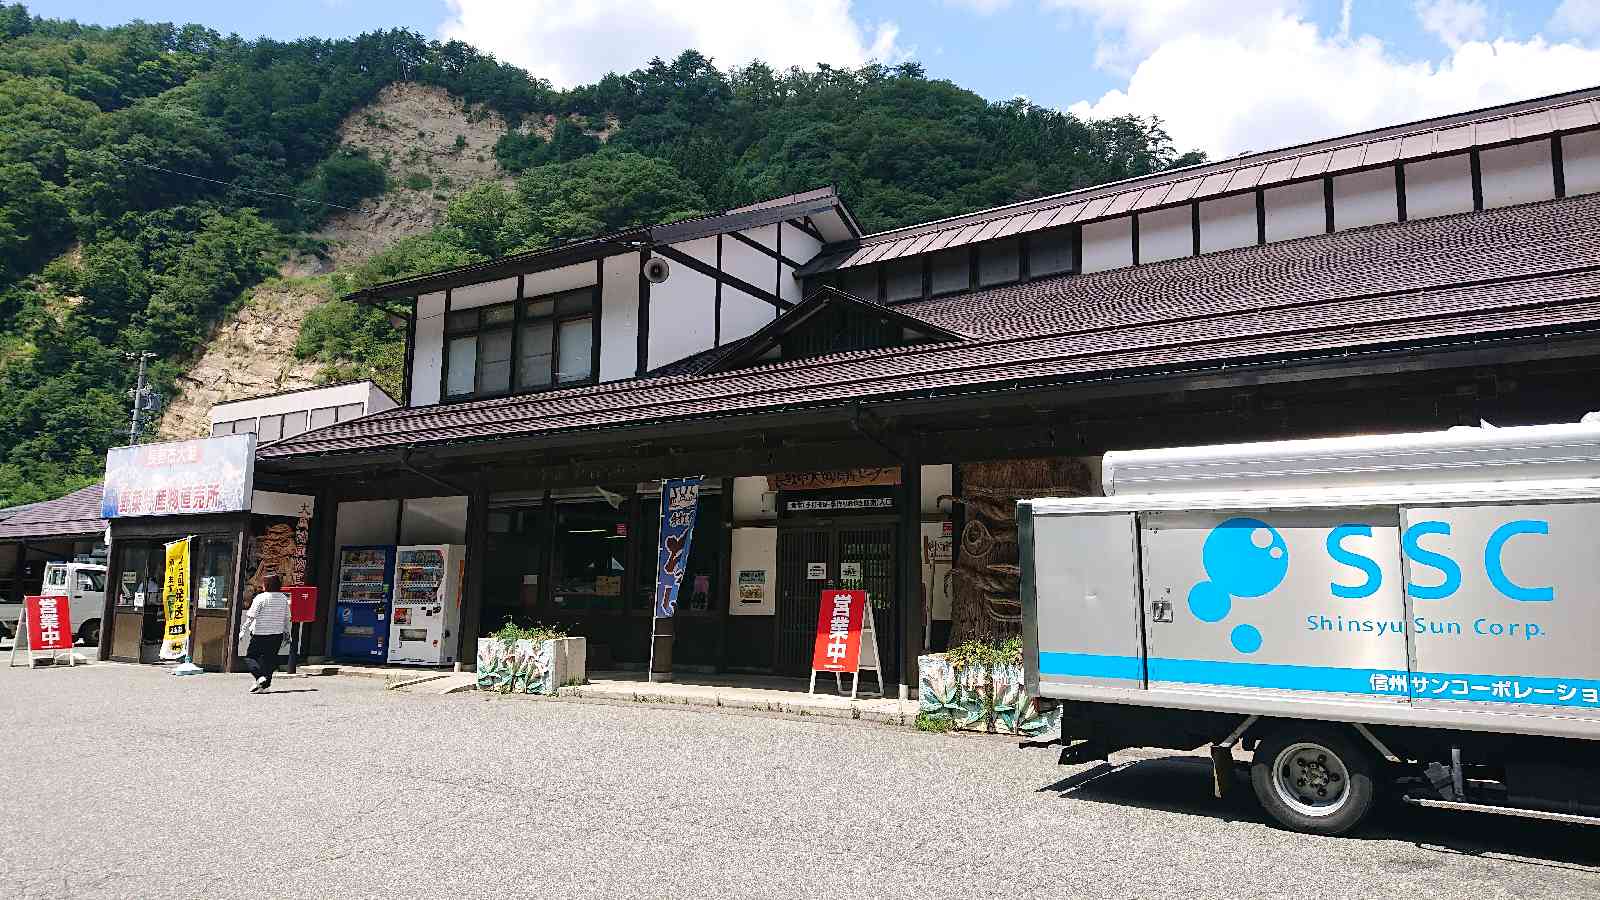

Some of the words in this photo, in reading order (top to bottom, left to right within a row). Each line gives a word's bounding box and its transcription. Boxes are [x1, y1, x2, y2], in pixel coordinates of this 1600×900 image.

[1326, 519, 1554, 602] SSC
[38, 598, 62, 645] 営業中
[826, 593, 853, 664] 営業中
[1306, 614, 1405, 637] Shinsyu
[1413, 617, 1462, 635] Sun
[1473, 618, 1546, 640] Corp.
